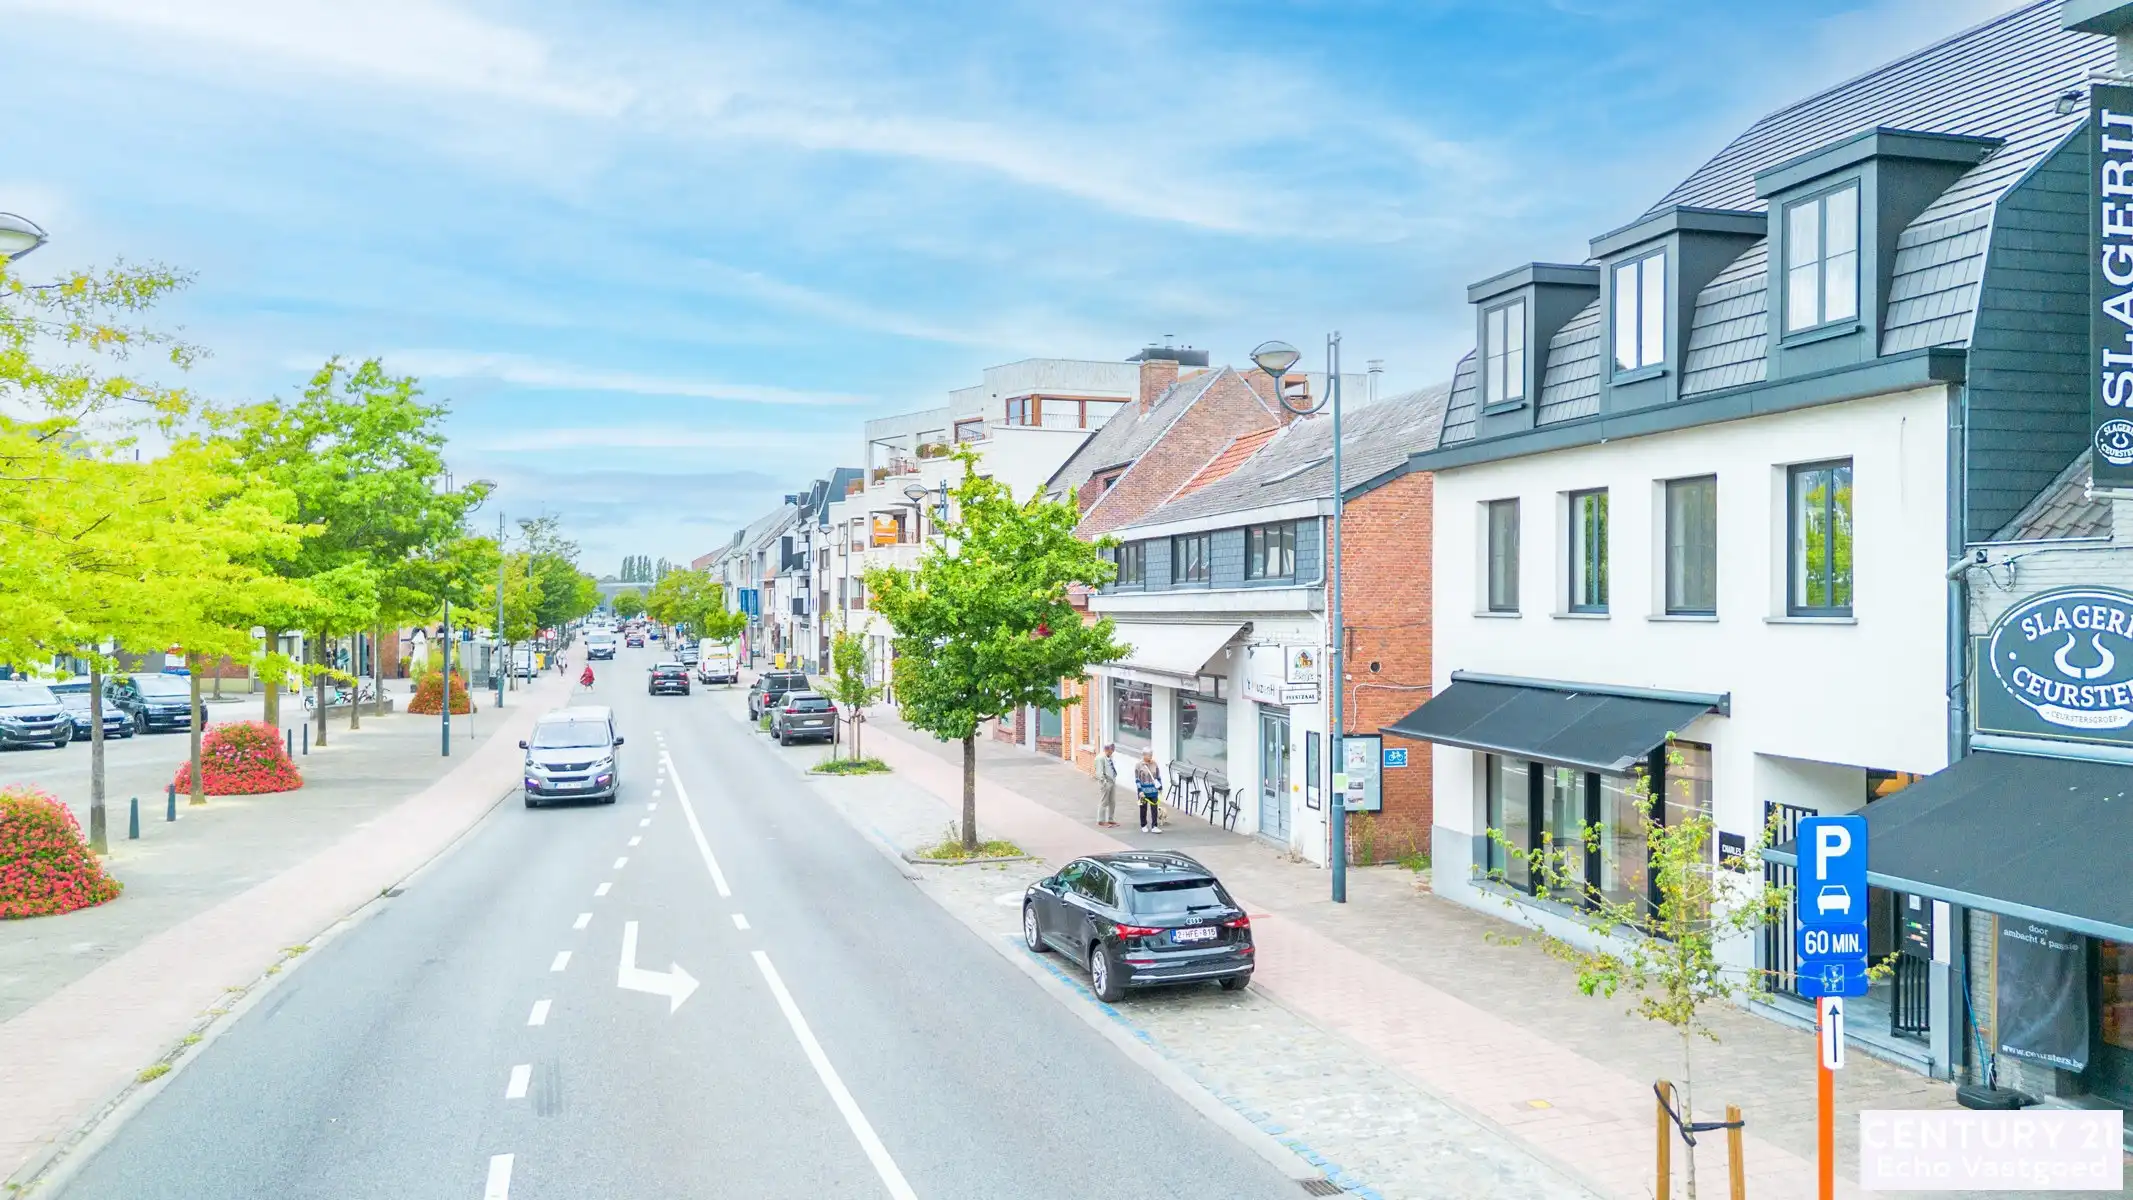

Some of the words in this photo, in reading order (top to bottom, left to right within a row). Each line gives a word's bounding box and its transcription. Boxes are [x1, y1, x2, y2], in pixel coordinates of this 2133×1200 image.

[1816, 825, 1851, 880] P
[2003, 929, 2038, 944] ambacht
[2029, 924, 2049, 936] door
[1805, 930, 1829, 954] 60
[1832, 933, 1863, 953] MIN.
